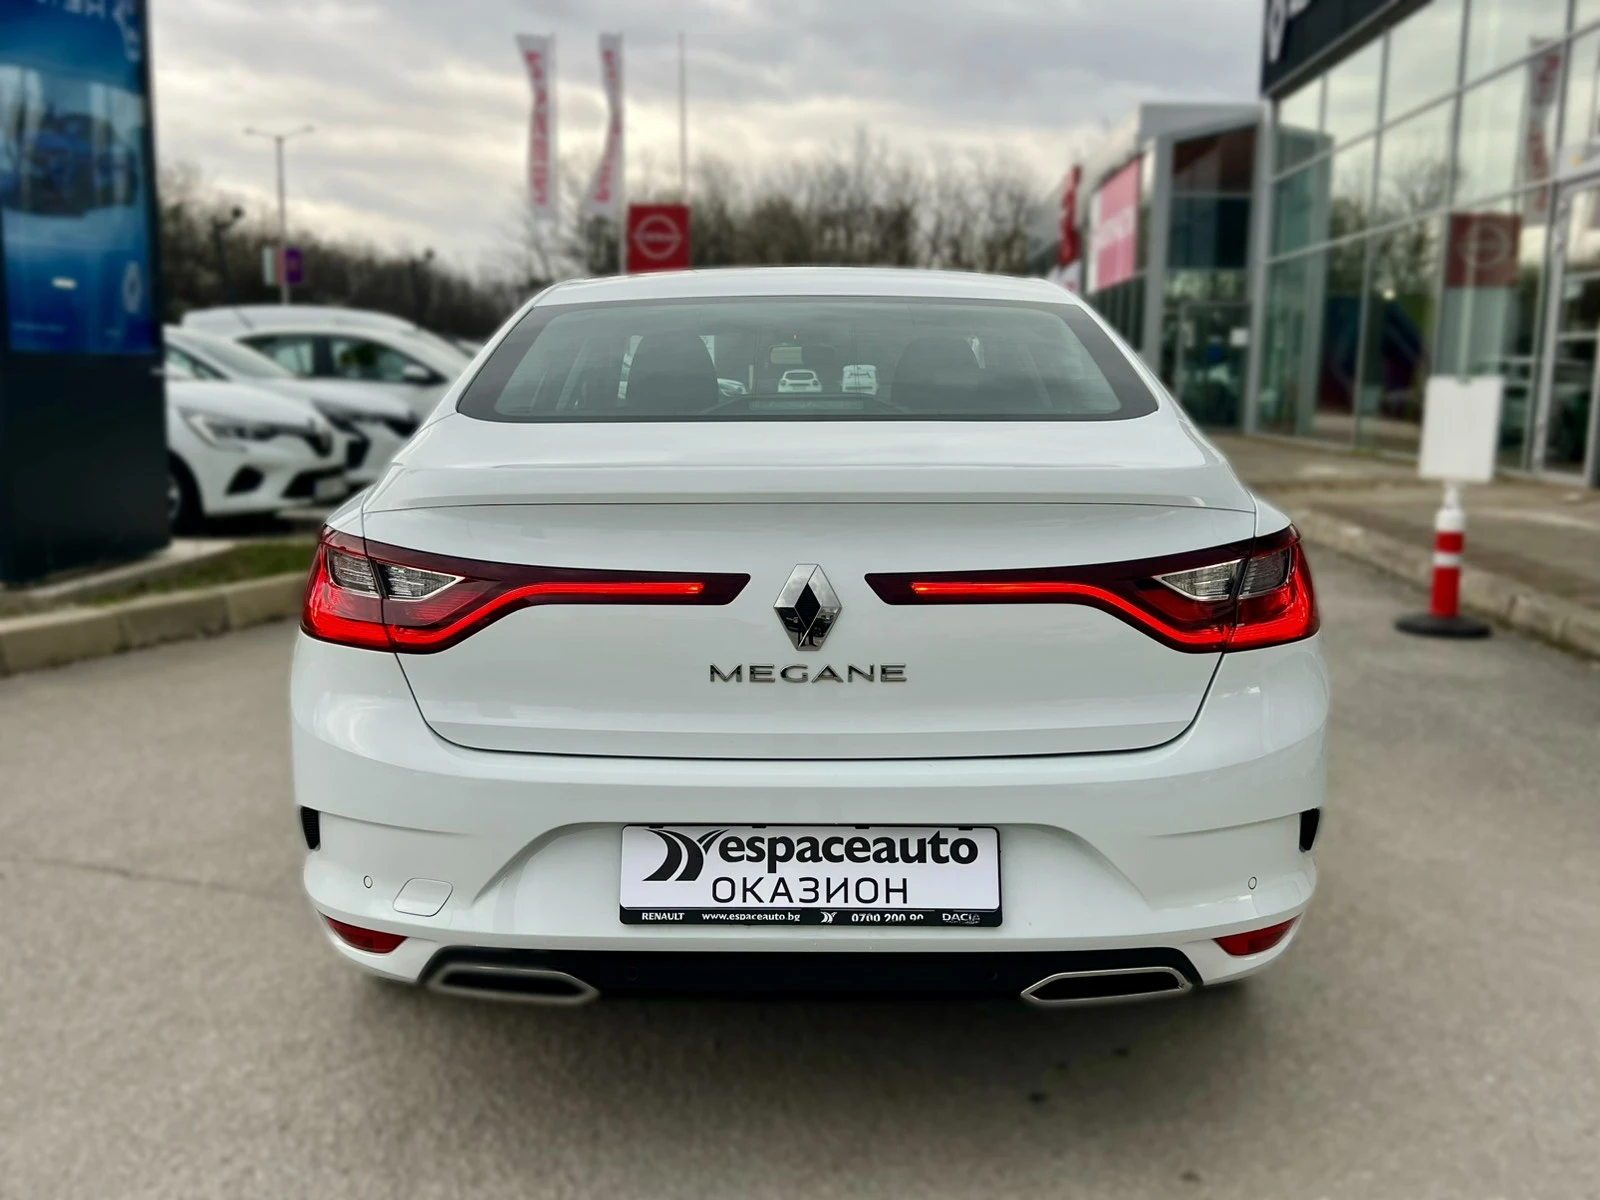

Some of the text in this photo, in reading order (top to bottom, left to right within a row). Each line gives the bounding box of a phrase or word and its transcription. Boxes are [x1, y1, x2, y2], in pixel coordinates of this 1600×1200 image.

[709, 663, 907, 683] MEGANE
[718, 830, 979, 873] espaceauto
[711, 876, 908, 905] ОКАЗИОН
[641, 912, 685, 921] RENAULT
[702, 912, 801, 922] www.espaceauto.bg
[851, 913, 881, 922] 0700
[884, 913, 906, 922] 200
[942, 913, 980, 921] DACIA
